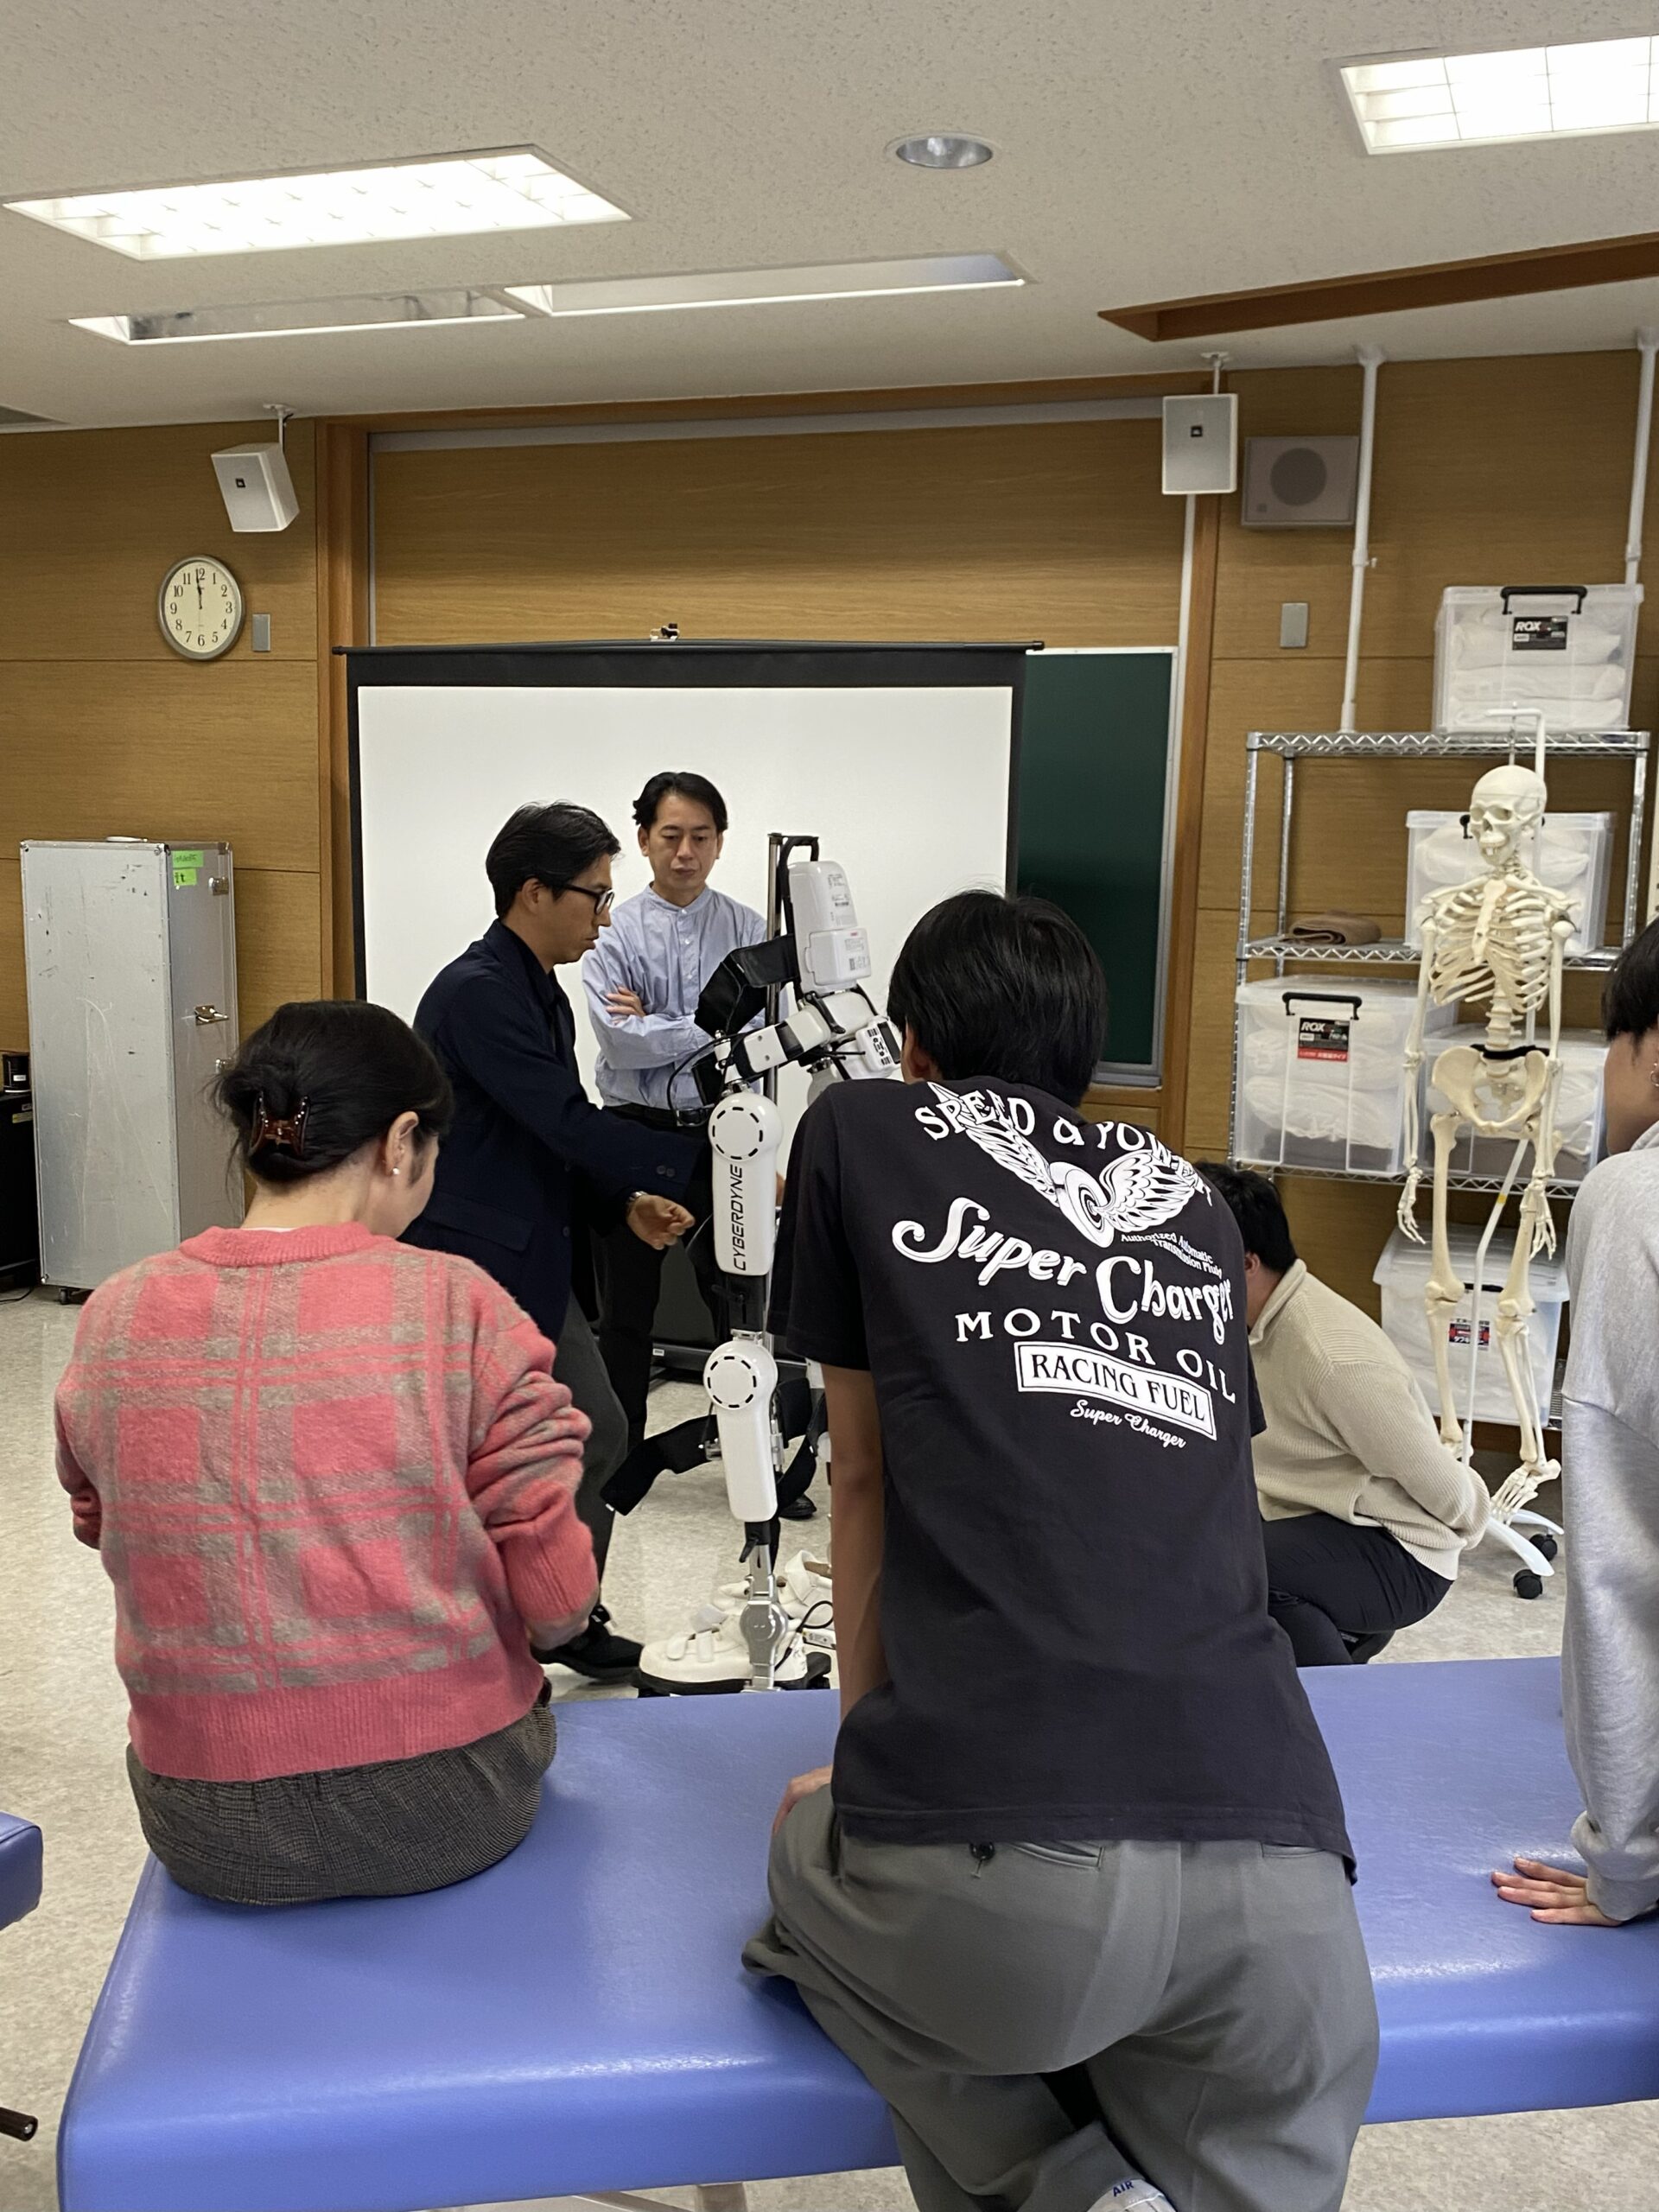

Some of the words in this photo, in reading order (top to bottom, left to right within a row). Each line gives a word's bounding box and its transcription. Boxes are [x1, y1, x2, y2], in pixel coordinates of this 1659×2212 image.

[183, 573, 191, 585] 11
[213, 572, 217, 585] 1
[174, 585, 184, 598] 10
[220, 584, 228, 597] 2
[170, 602, 178, 614] 9
[226, 601, 232, 613] 3
[175, 619, 183, 631] 8
[221, 619, 228, 630] 4
[1515, 621, 1541, 632] ROX
[186, 631, 192, 643] 7
[198, 634, 205, 646] 6
[212, 632, 219, 643] 5
[1301, 1021, 1325, 1033] ROX
[914, 1089, 1036, 1141] SPEED
[730, 1164, 747, 1271] CYBERDYNE
[1122, 1232, 1178, 1243] Authorized
[892, 1197, 1087, 1287] Super
[1095, 1255, 1235, 1345] Charger
[955, 1307, 1157, 1365] MOTOR
[1176, 1349, 1236, 1404] OIL
[1031, 1354, 1139, 1399] RACING
[1146, 1380, 1206, 1422] FUEL
[1070, 1399, 1122, 1426] Super
[1124, 1413, 1187, 1449] Charger
[1113, 2180, 1135, 2197] AIR
